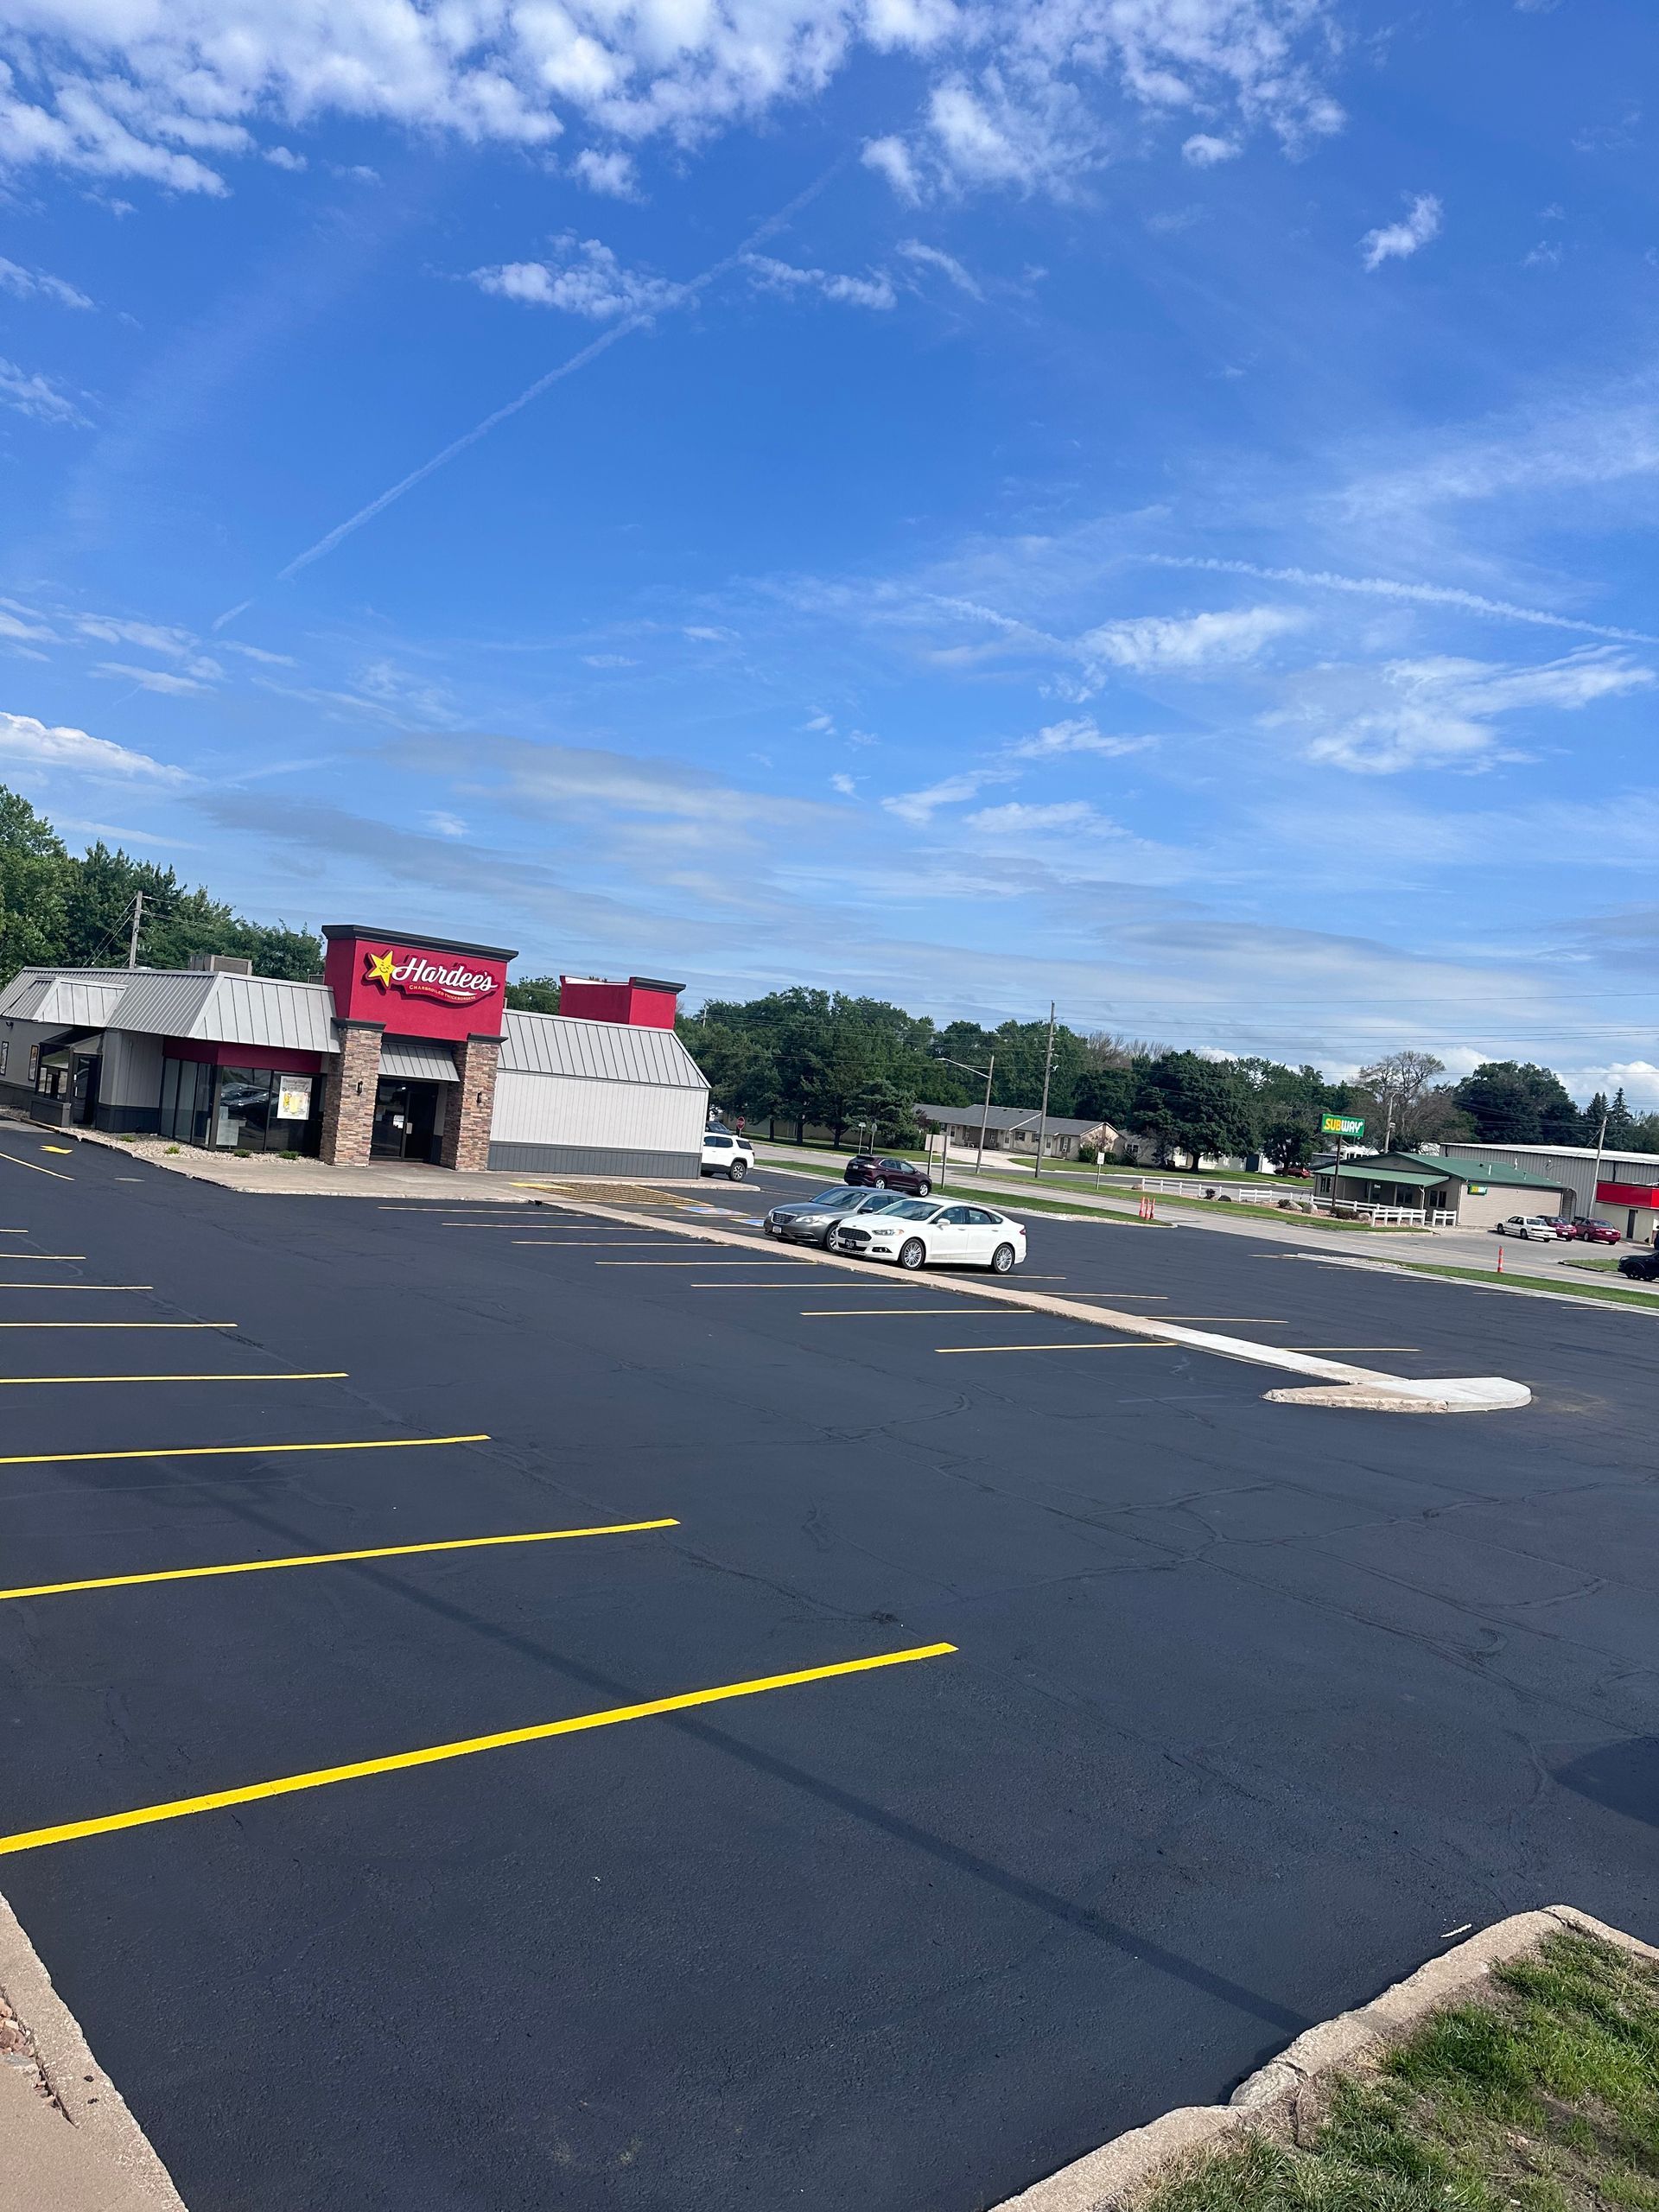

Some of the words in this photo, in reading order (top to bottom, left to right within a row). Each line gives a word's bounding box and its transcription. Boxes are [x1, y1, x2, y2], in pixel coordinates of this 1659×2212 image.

[391, 957, 498, 992] Hardee's
[409, 984, 444, 996] CHARBROILED
[1324, 1118, 1363, 1133] SUBWAY
